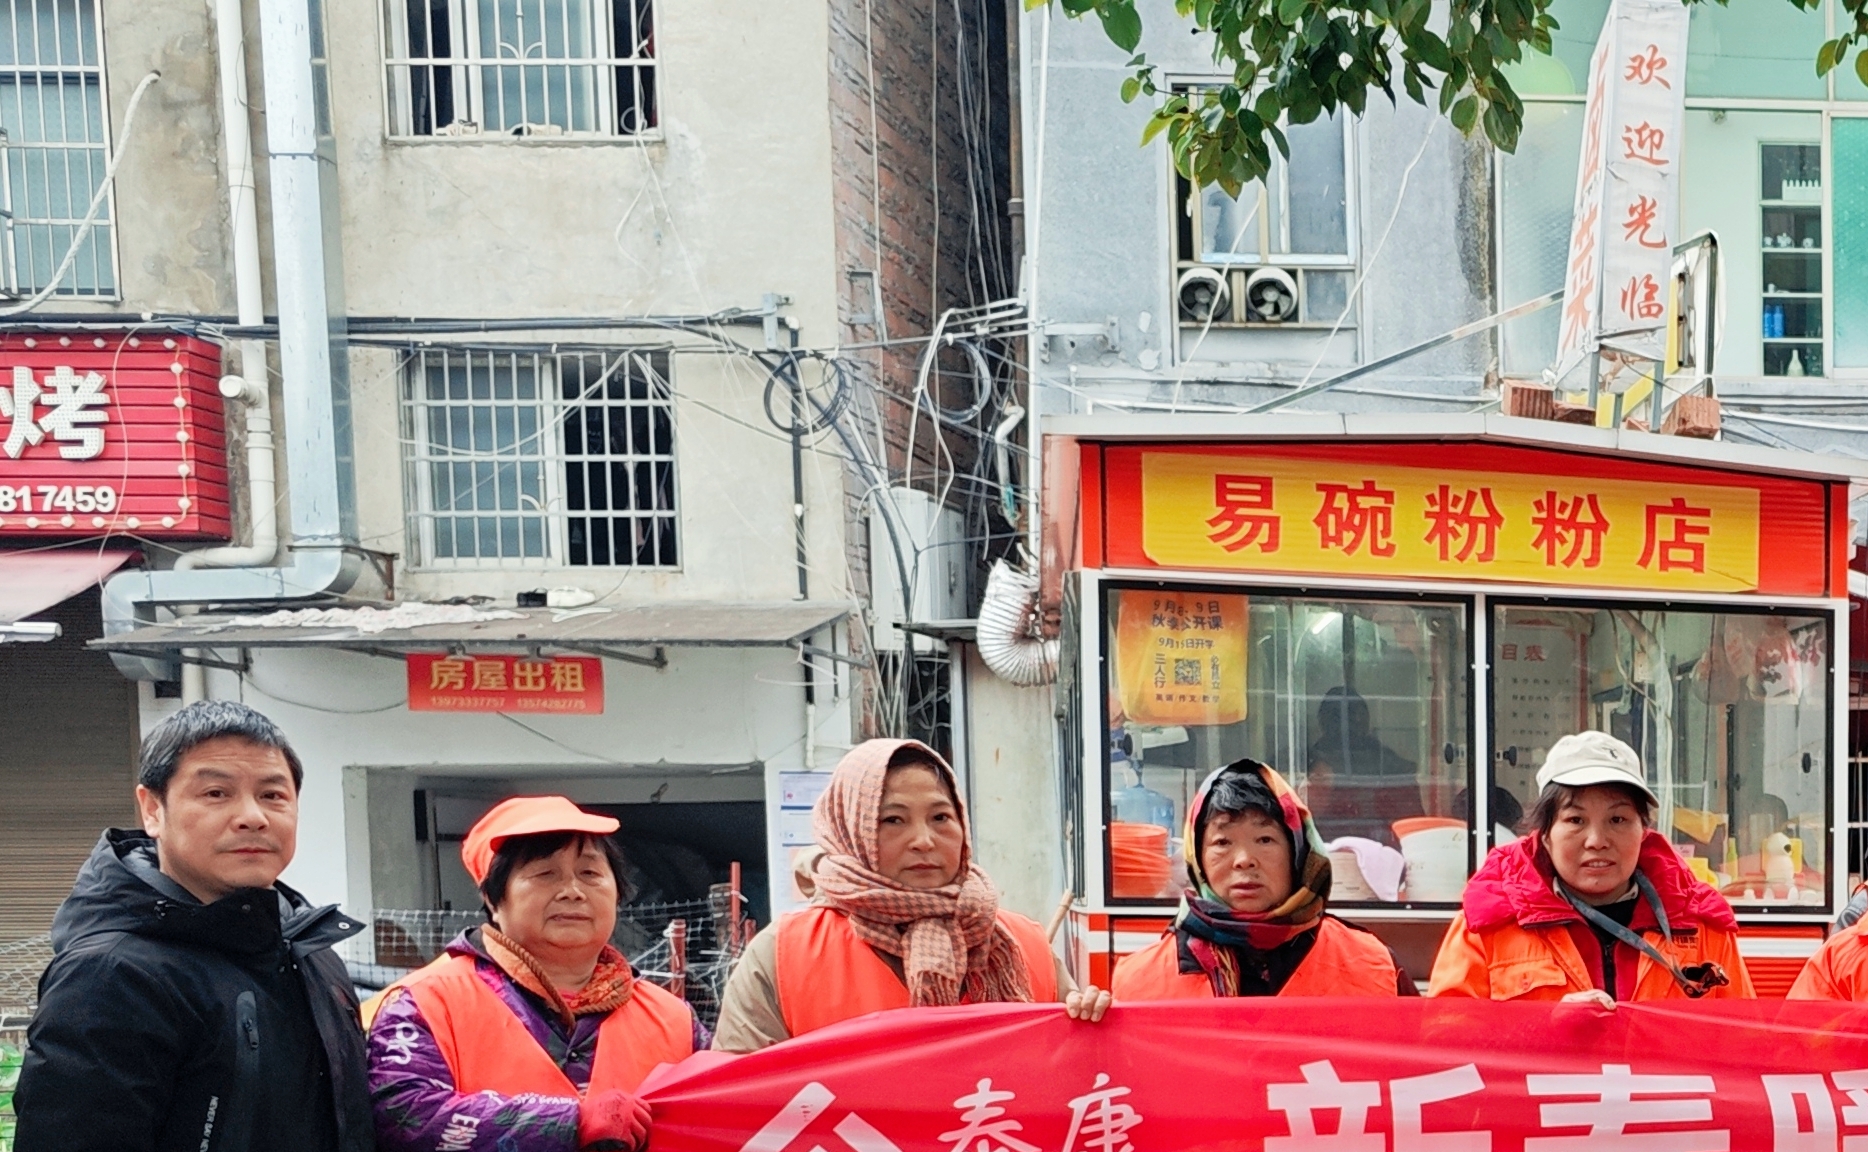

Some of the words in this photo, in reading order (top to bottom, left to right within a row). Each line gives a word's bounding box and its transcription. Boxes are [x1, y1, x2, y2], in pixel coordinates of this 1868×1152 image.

[1620, 43, 1672, 322] 欢迎光临
[0, 484, 117, 513] 817459
[1206, 474, 1713, 574] 易碗粉粉店
[430, 659, 586, 693] 房屋出租
[1154, 653, 1167, 689] 三人行
